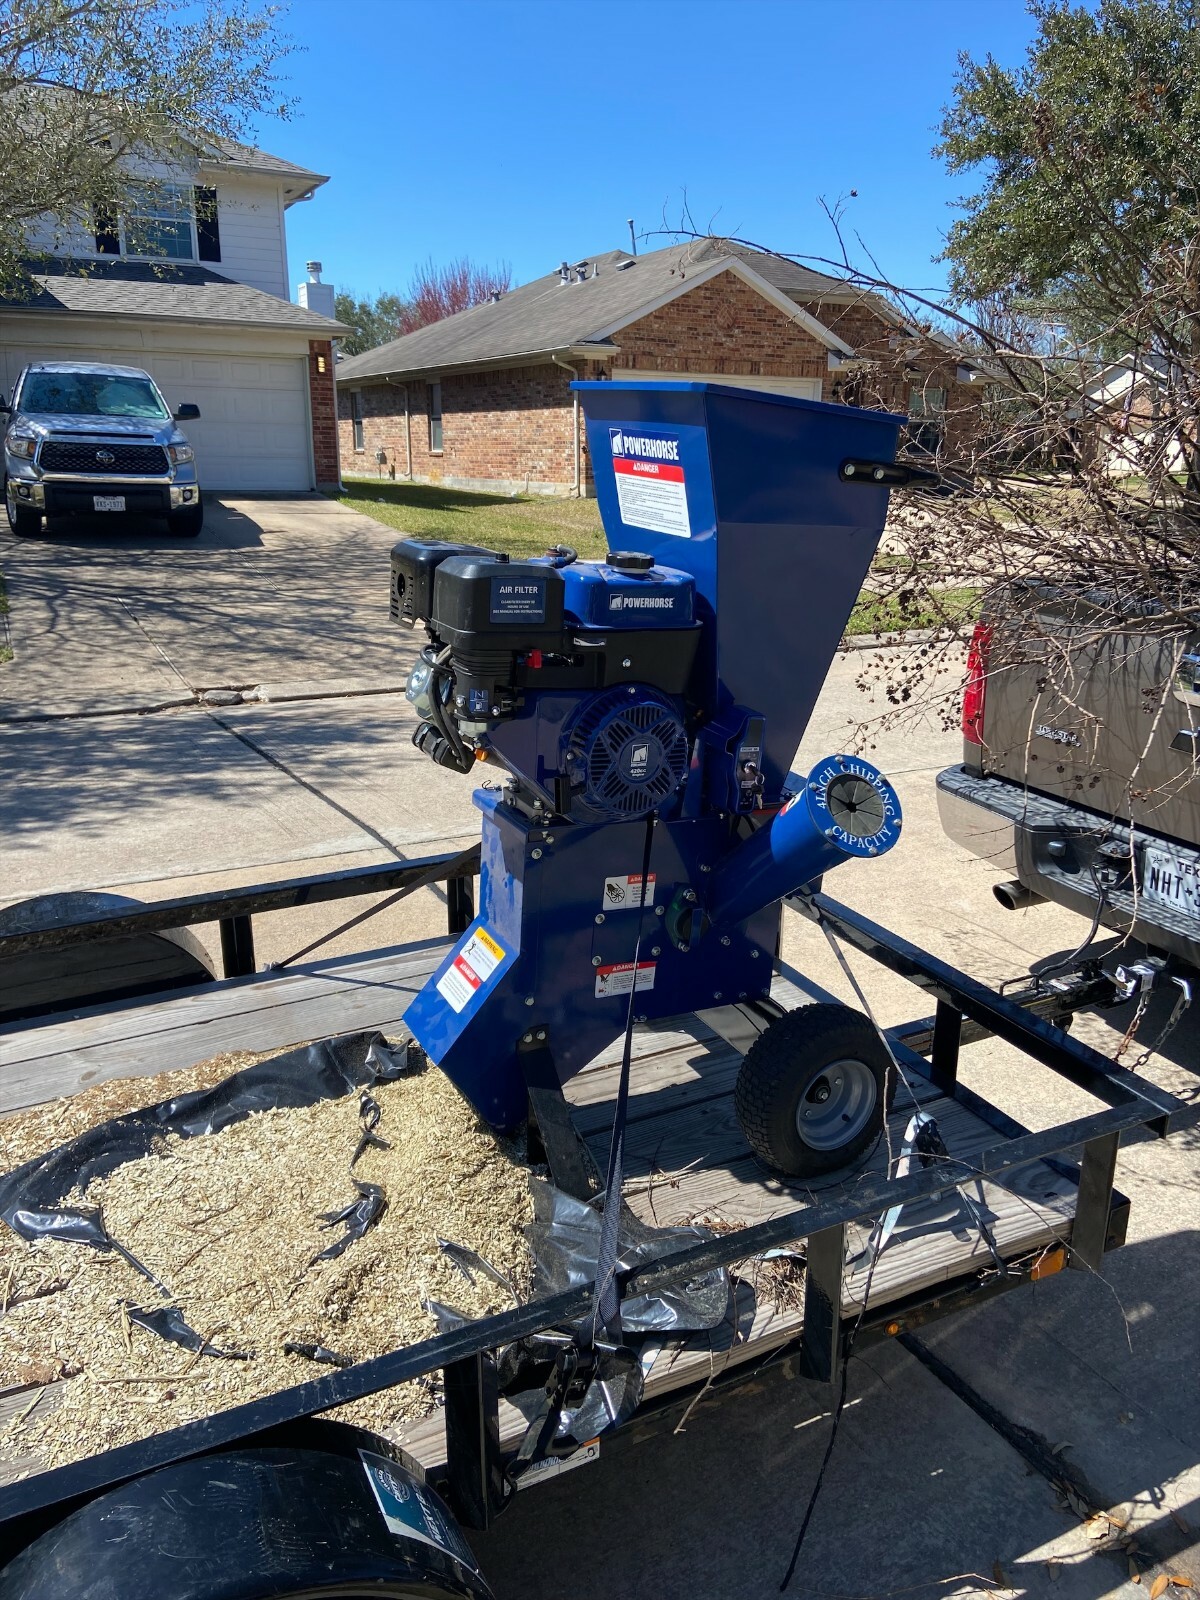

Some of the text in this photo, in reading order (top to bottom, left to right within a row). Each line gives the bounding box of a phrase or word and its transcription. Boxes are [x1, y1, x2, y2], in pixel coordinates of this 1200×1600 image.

[623, 436, 679, 460] POWERHORSE
[637, 462, 659, 474] DANGER
[623, 597, 674, 608] POWERHORSE
[840, 763, 895, 816] CHIPPING
[832, 825, 892, 848] CAPACITY
